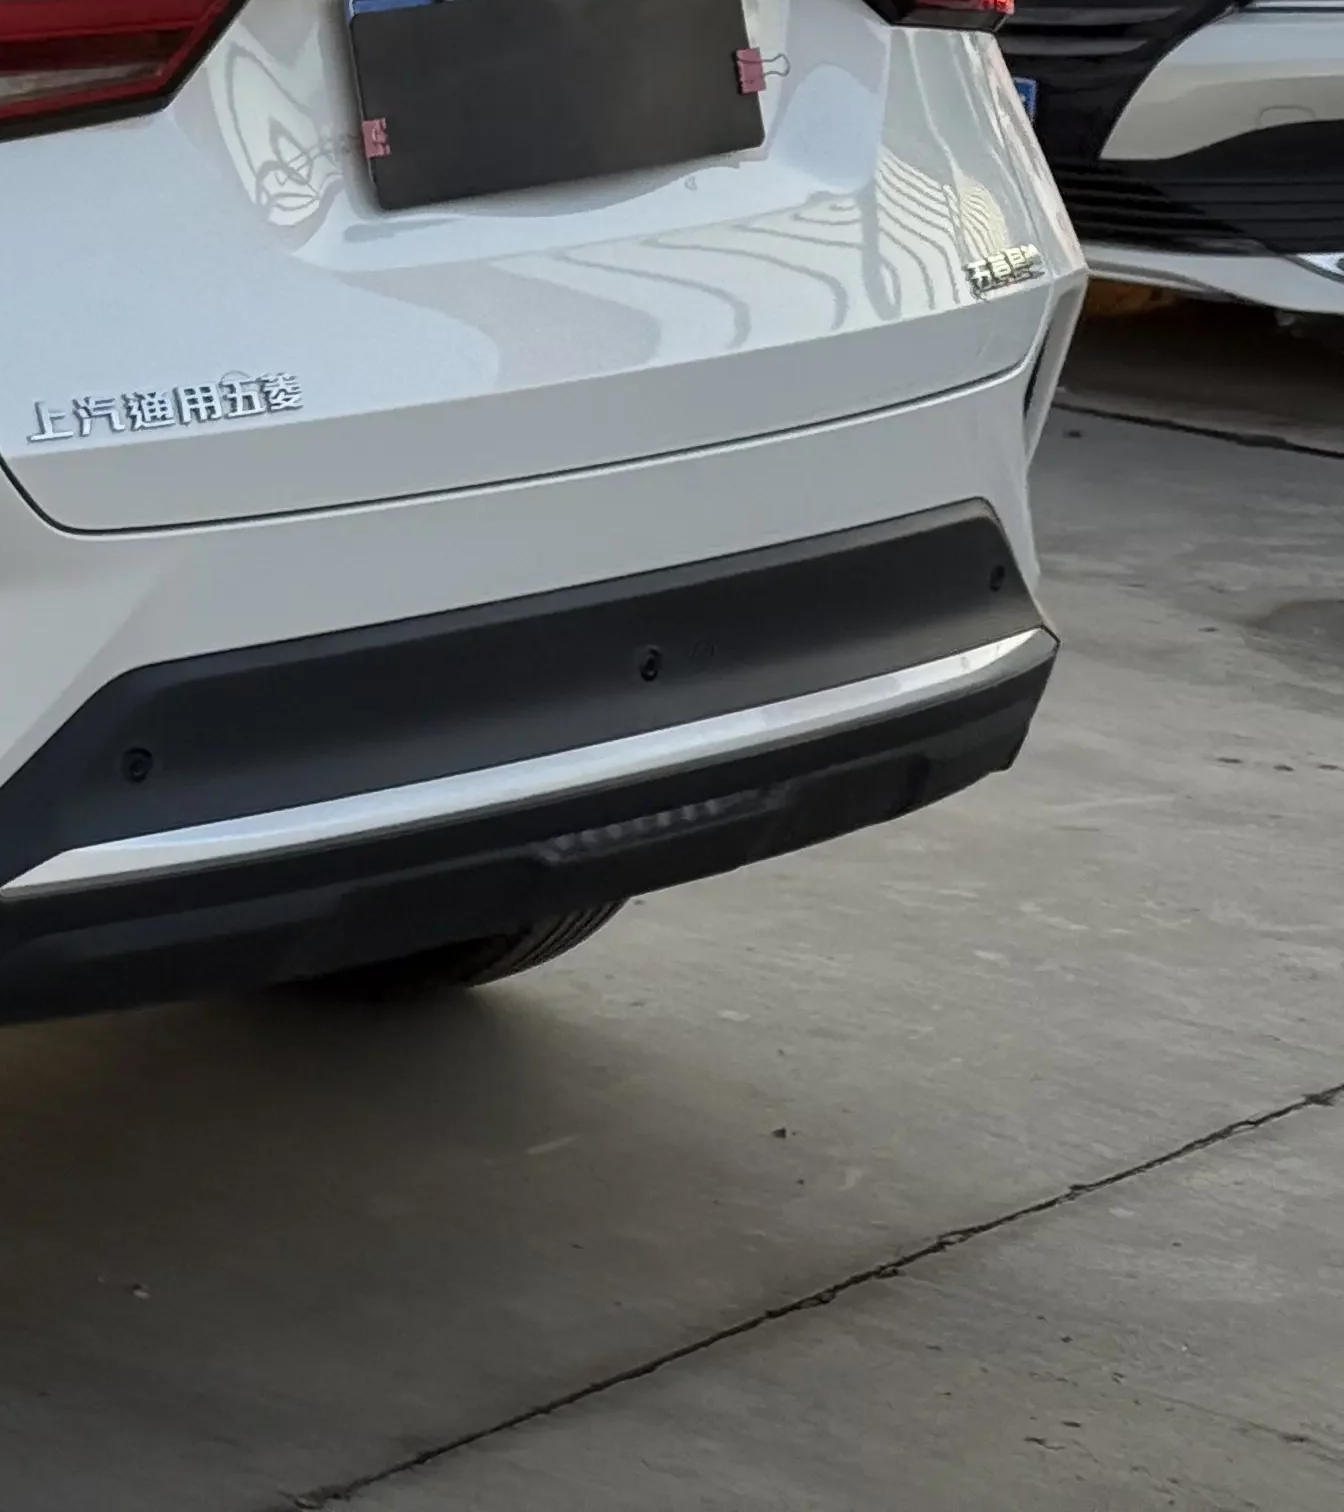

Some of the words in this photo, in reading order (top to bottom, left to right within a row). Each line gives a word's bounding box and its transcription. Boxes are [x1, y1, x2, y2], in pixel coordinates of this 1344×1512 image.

[26, 371, 304, 444] 上汽通用五菱
